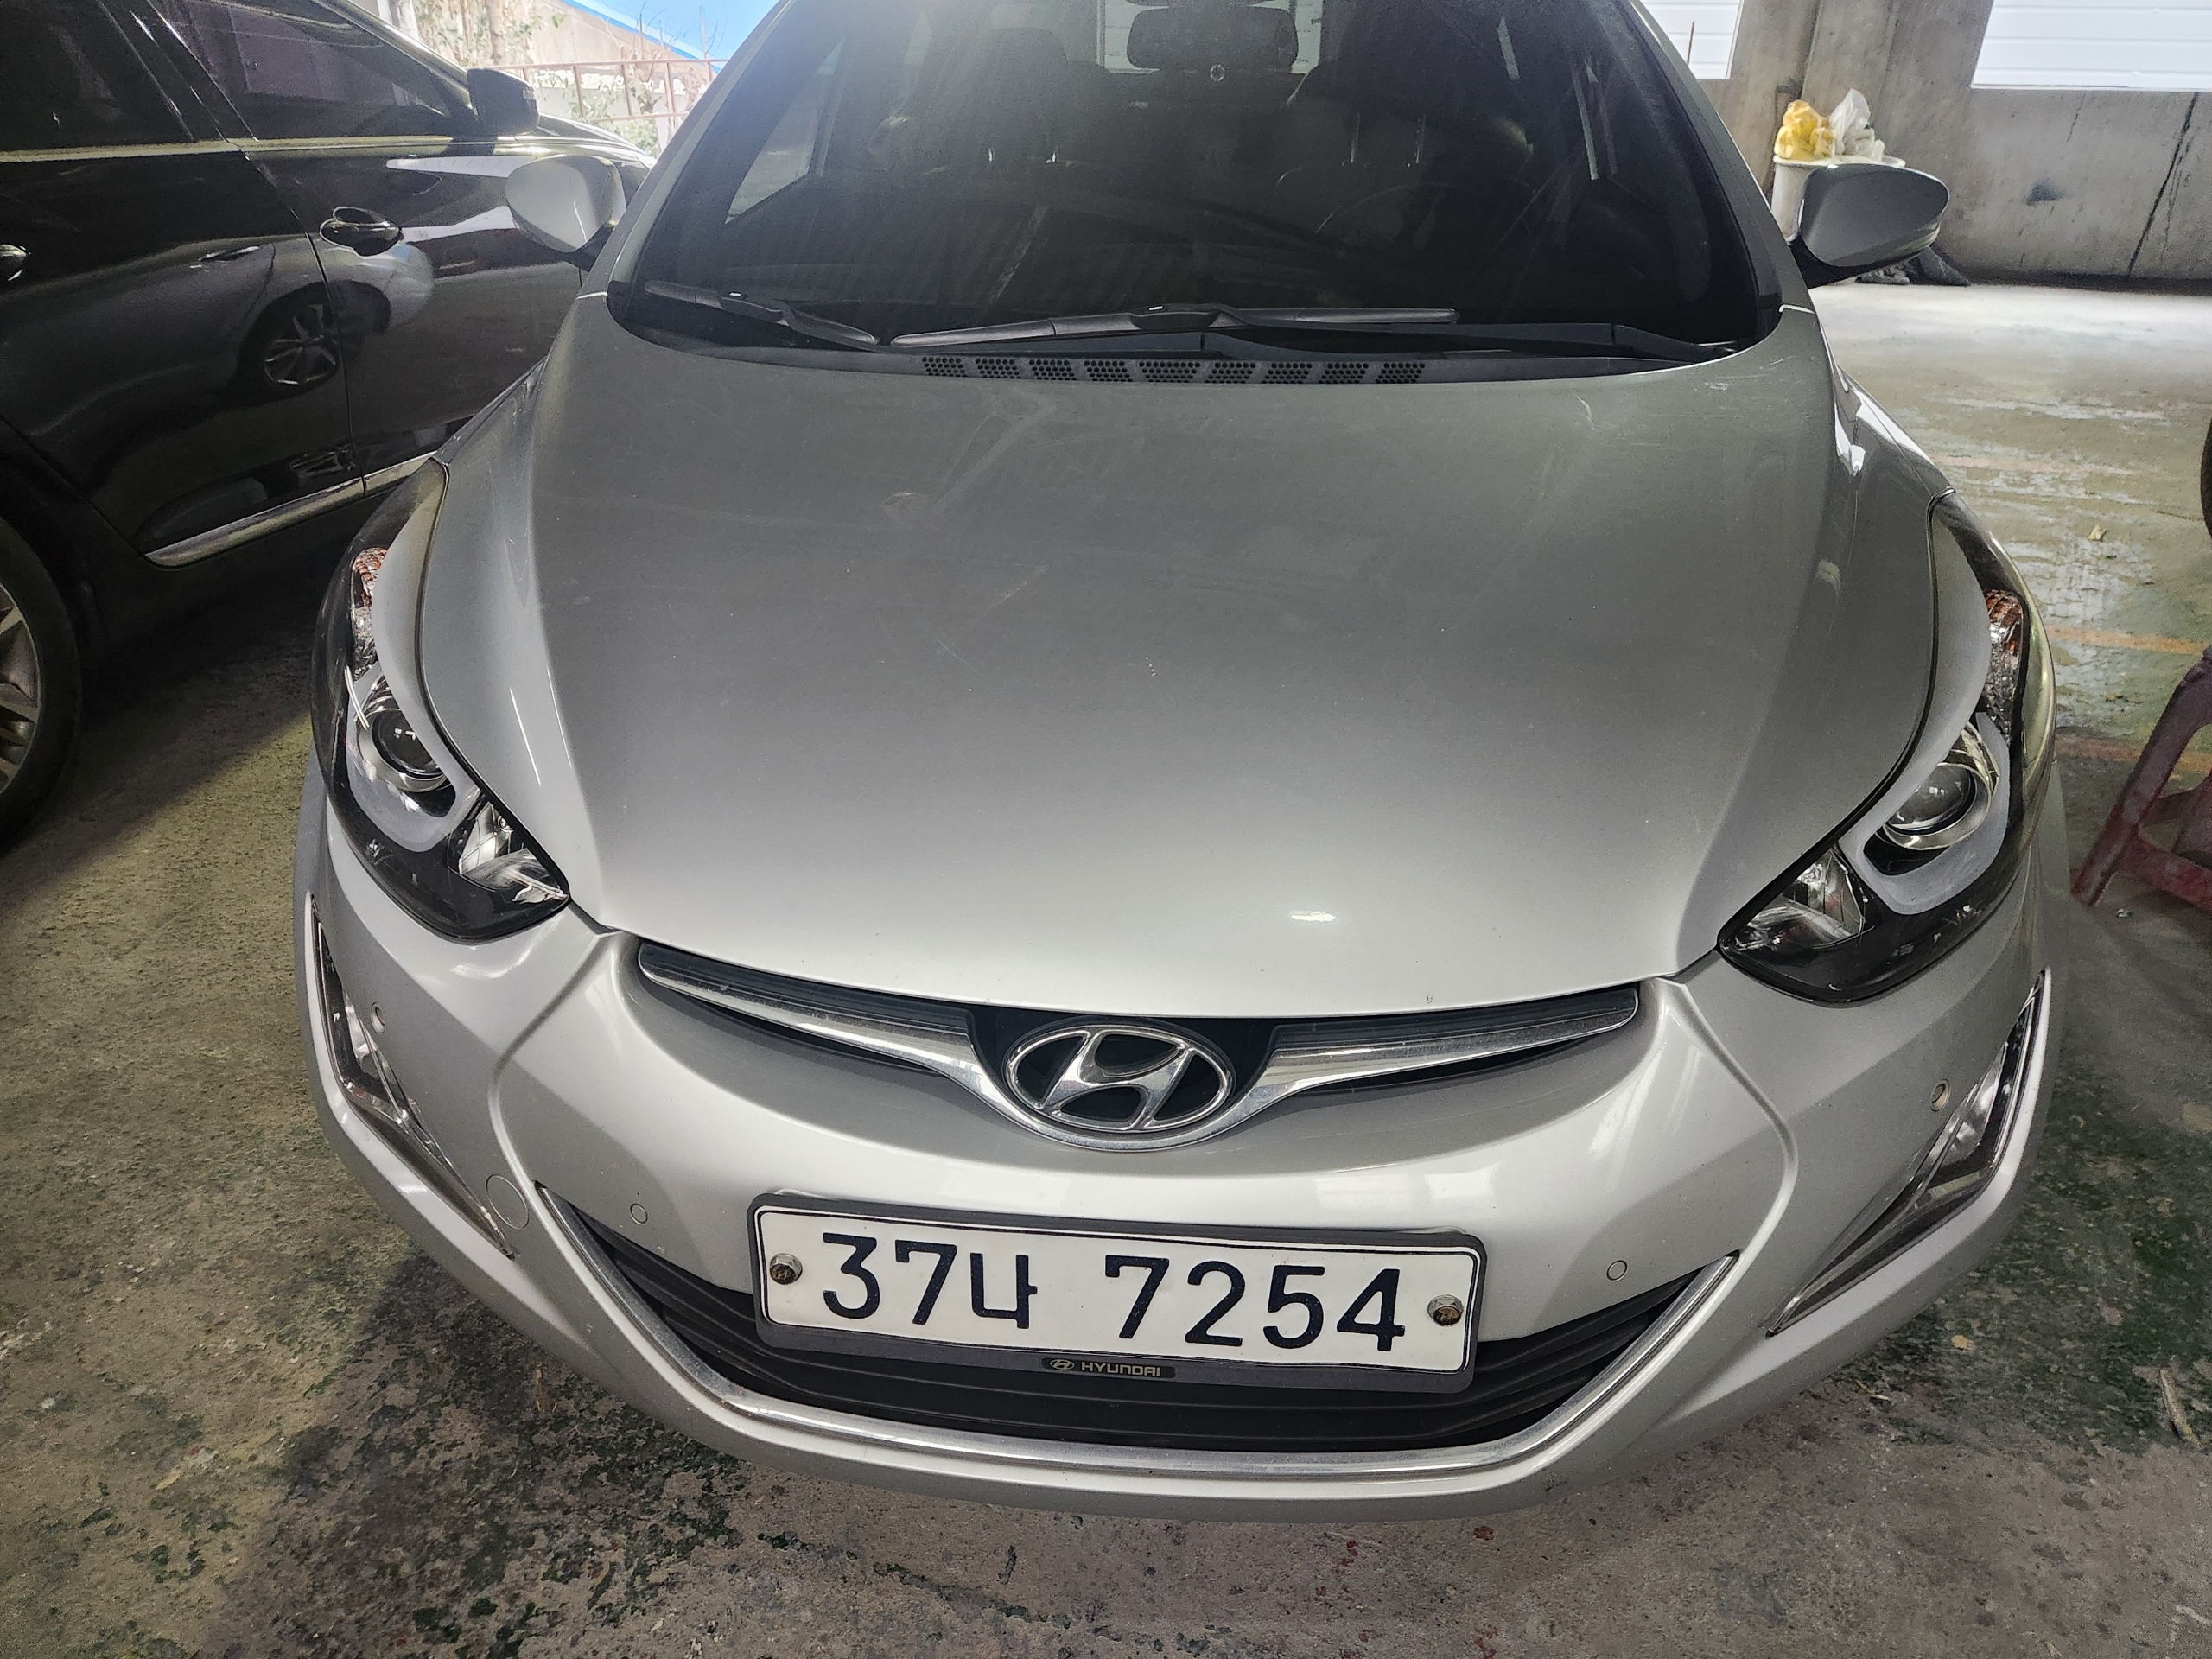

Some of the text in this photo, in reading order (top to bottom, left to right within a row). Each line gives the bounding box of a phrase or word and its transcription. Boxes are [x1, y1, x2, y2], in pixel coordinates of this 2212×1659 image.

[823, 1232, 1405, 1351] 37나 7254
[1081, 1361, 1160, 1377] HYUNDAI
